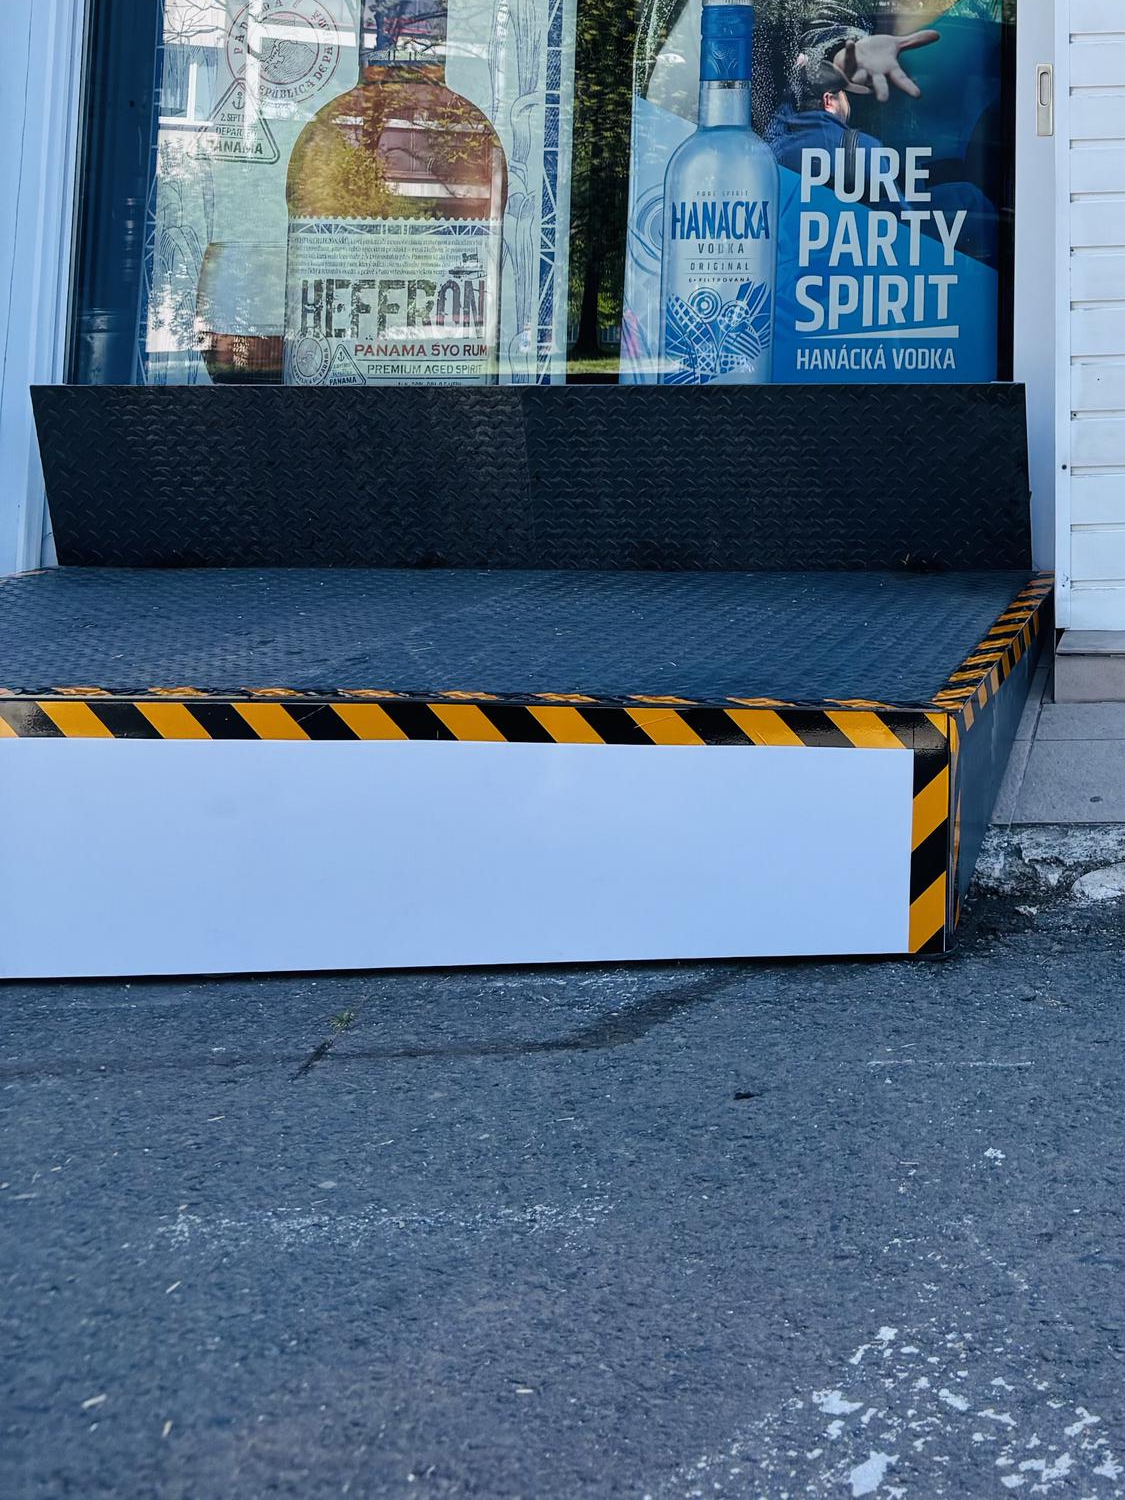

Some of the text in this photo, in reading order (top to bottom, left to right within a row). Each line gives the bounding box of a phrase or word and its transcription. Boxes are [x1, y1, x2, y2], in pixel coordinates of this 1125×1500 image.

[800, 147, 932, 204] PURE
[698, 243, 744, 254] VODKA
[799, 210, 967, 268] PARTY
[690, 262, 750, 271] ORIGINAL
[300, 279, 485, 339] HEFFRON
[795, 274, 959, 332] SPIRIT
[354, 344, 427, 357] PANAMA
[463, 344, 488, 357] RUM
[797, 344, 957, 370] HANÁCKÁ VODKA
[367, 364, 482, 374] PREMIUM AGED SPIRIT
